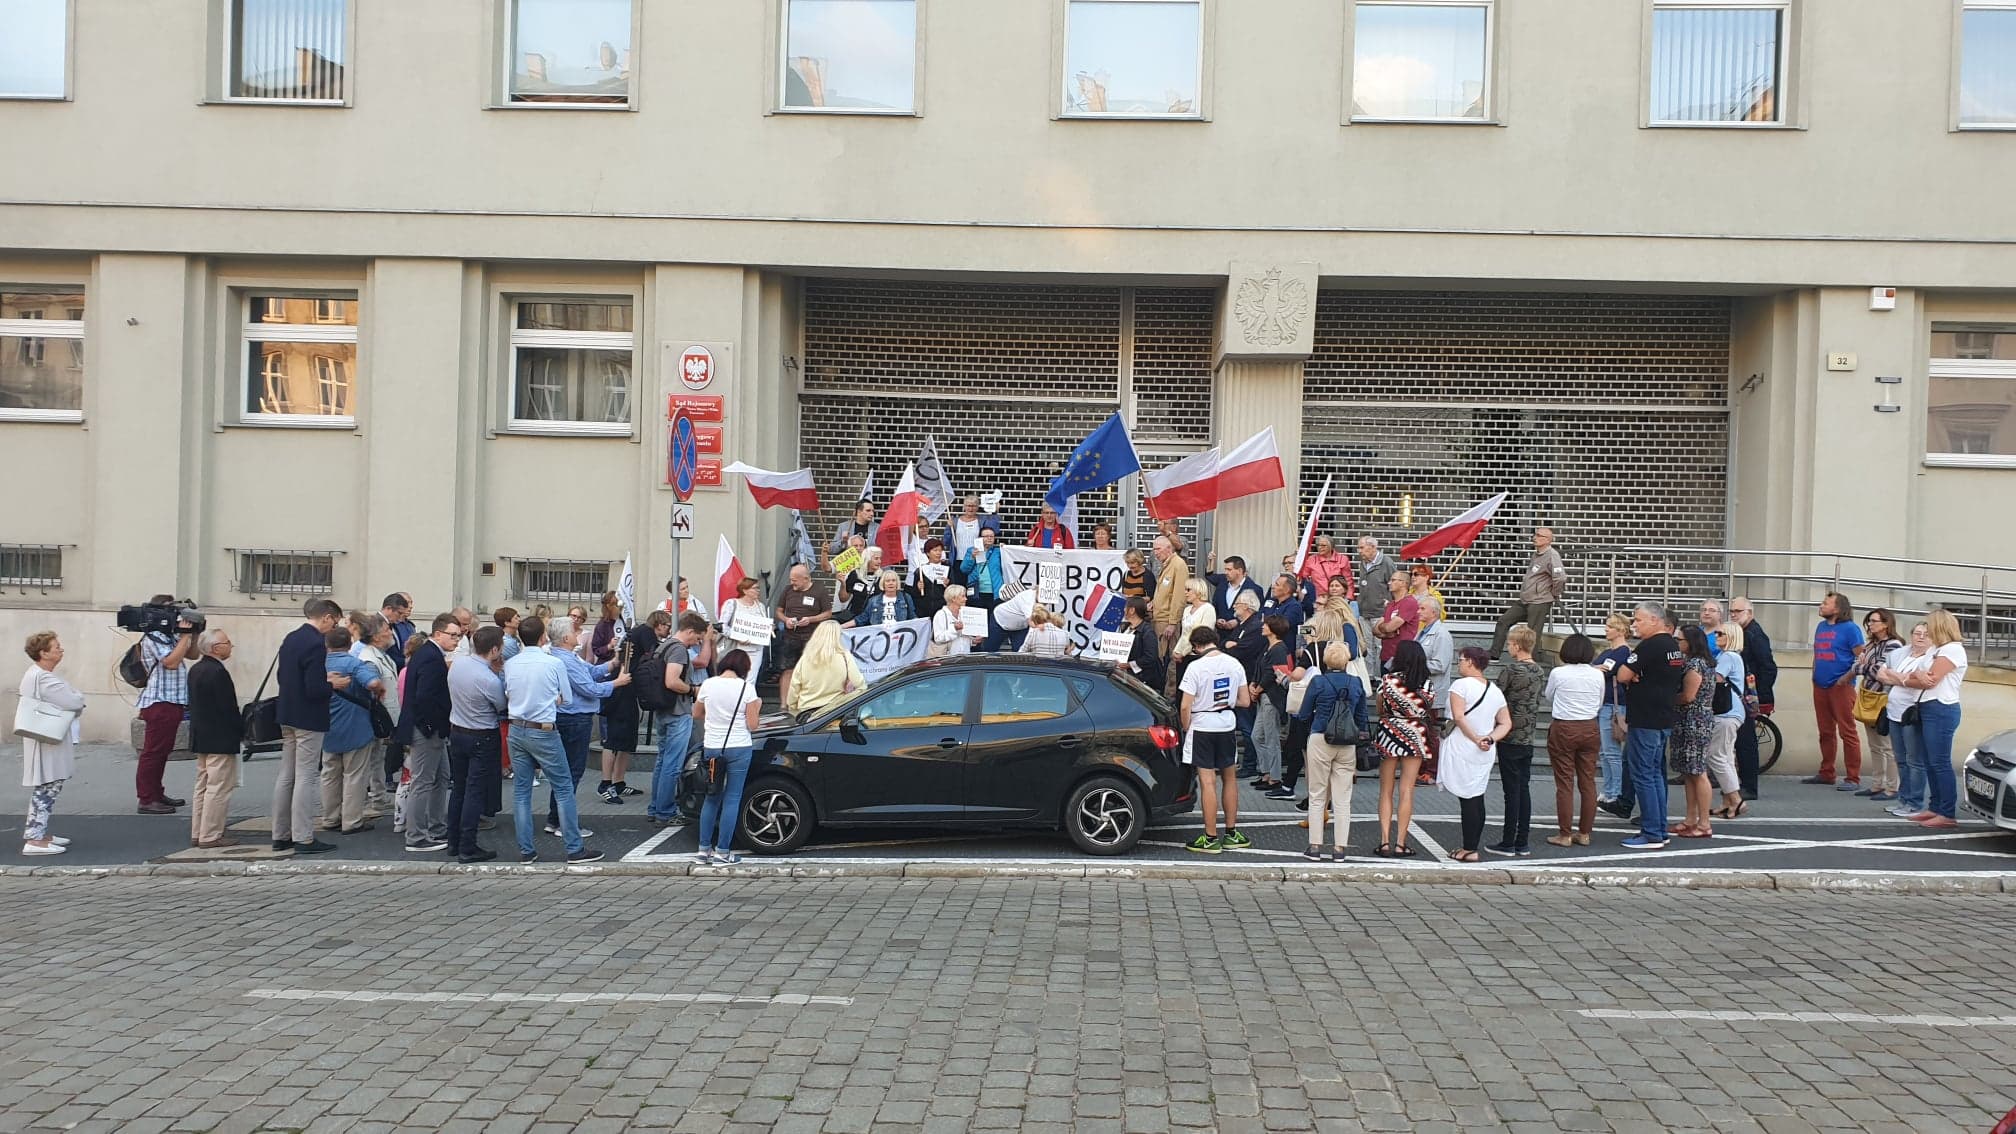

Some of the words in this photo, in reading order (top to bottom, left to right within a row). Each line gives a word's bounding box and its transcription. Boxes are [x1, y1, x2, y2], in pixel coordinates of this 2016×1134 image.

[1837, 357, 1848, 365] 32
[1013, 561, 1123, 592] ZIBRO
[850, 627, 918, 664] KOD
